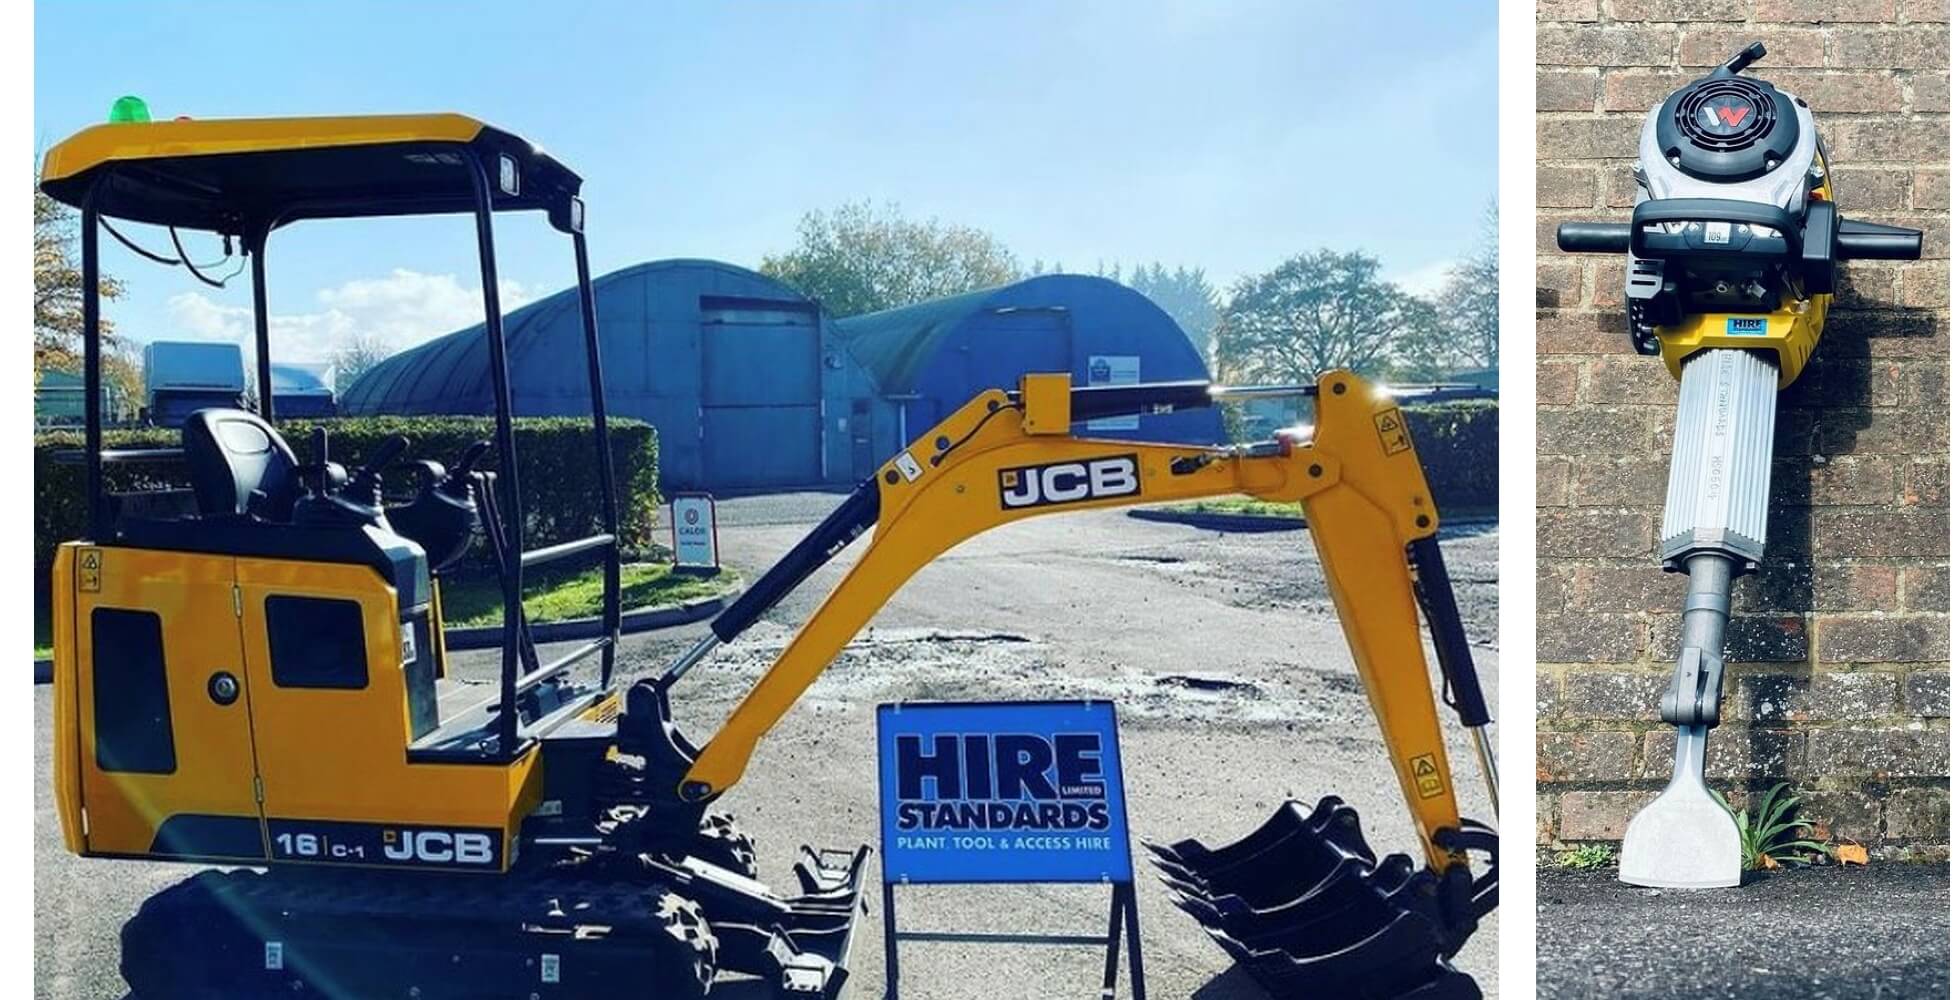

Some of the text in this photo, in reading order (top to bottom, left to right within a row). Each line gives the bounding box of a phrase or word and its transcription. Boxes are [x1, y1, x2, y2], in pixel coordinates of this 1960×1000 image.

[1003, 458, 1138, 506] JCB
[895, 733, 1106, 801] HIRE
[1061, 785, 1102, 796] LIMITED
[896, 801, 1111, 832] STANDARDS
[277, 833, 318, 855] 16
[384, 831, 493, 863] JCB
[952, 837, 994, 849] TOOL
[1000, 838, 1009, 849] &
[1014, 837, 1071, 849] ACCESS
[1076, 837, 1111, 850] HIRE
